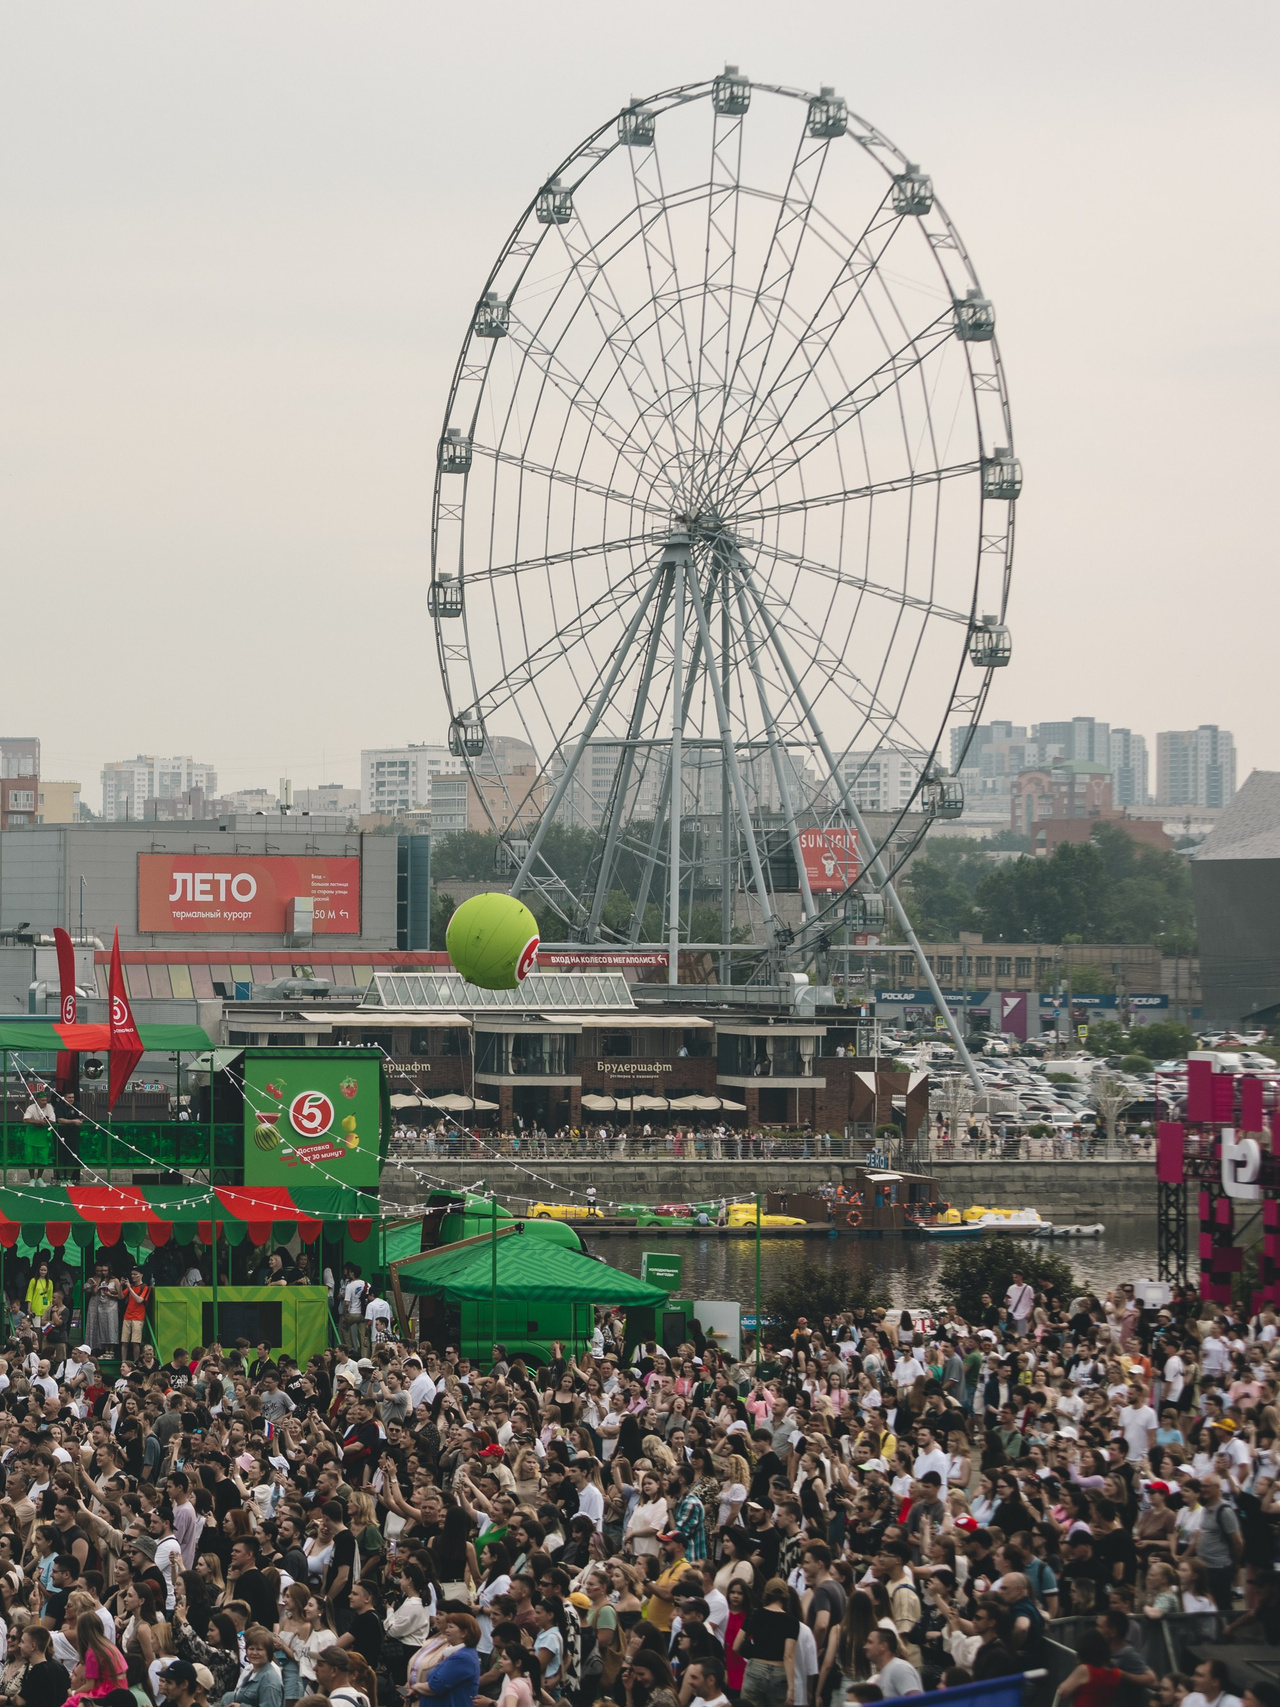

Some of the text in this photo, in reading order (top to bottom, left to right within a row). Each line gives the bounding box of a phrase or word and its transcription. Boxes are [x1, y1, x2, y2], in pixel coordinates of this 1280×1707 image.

[169, 873, 257, 902] ЛЕТО
[172, 910, 252, 921] термальный курорт
[551, 956, 570, 964] ВХОД
[597, 1062, 672, 1073] Брудершафт
[301, 1095, 324, 1128] 5
[298, 1144, 330, 1154] Доставка
[321, 1150, 343, 1158] минут
